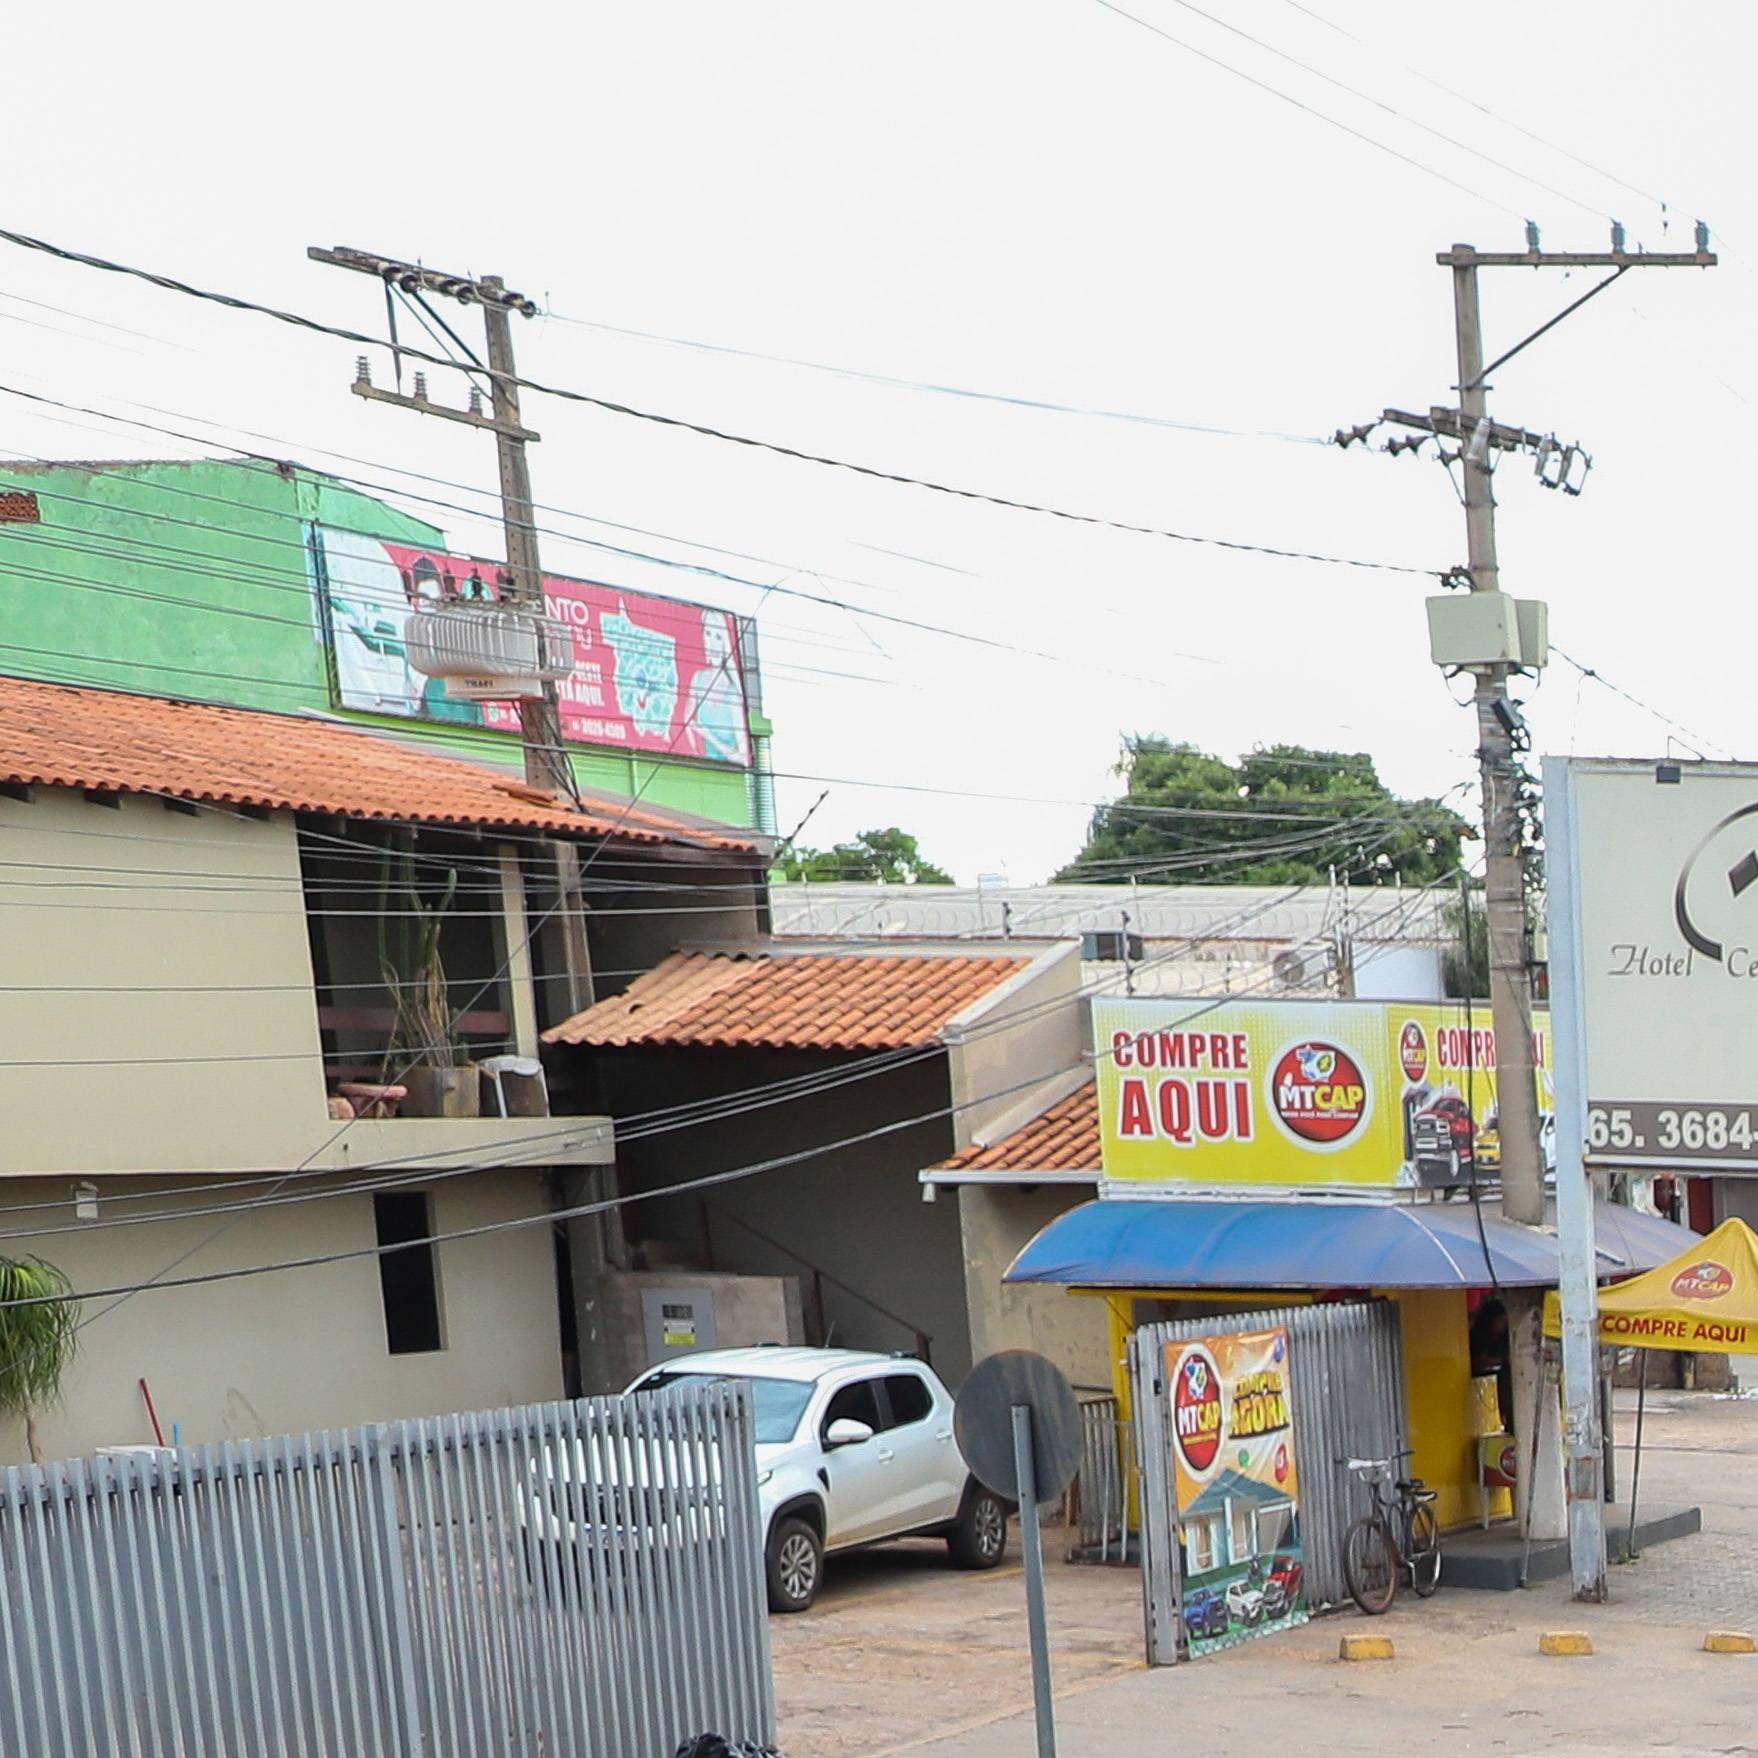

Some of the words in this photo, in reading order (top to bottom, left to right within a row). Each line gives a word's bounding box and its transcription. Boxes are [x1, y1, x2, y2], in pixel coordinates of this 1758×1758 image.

[545, 594, 589, 625] NTO
[1606, 943, 1695, 979] Hotel
[1112, 1030, 1249, 1070] COMPRE
[1436, 1027, 1496, 1068] COMPR
[1119, 1078, 1253, 1143] AQUI
[1278, 1083, 1364, 1110] MTCAP
[1588, 1109, 1645, 1150] 65.
[1675, 1277, 1731, 1293] MTCAP
[1601, 1314, 1687, 1338] COMPRE
[1693, 1322, 1746, 1344] AQUI
[1177, 1401, 1221, 1436] MTCAP
[1228, 1393, 1290, 1438] AGORA
